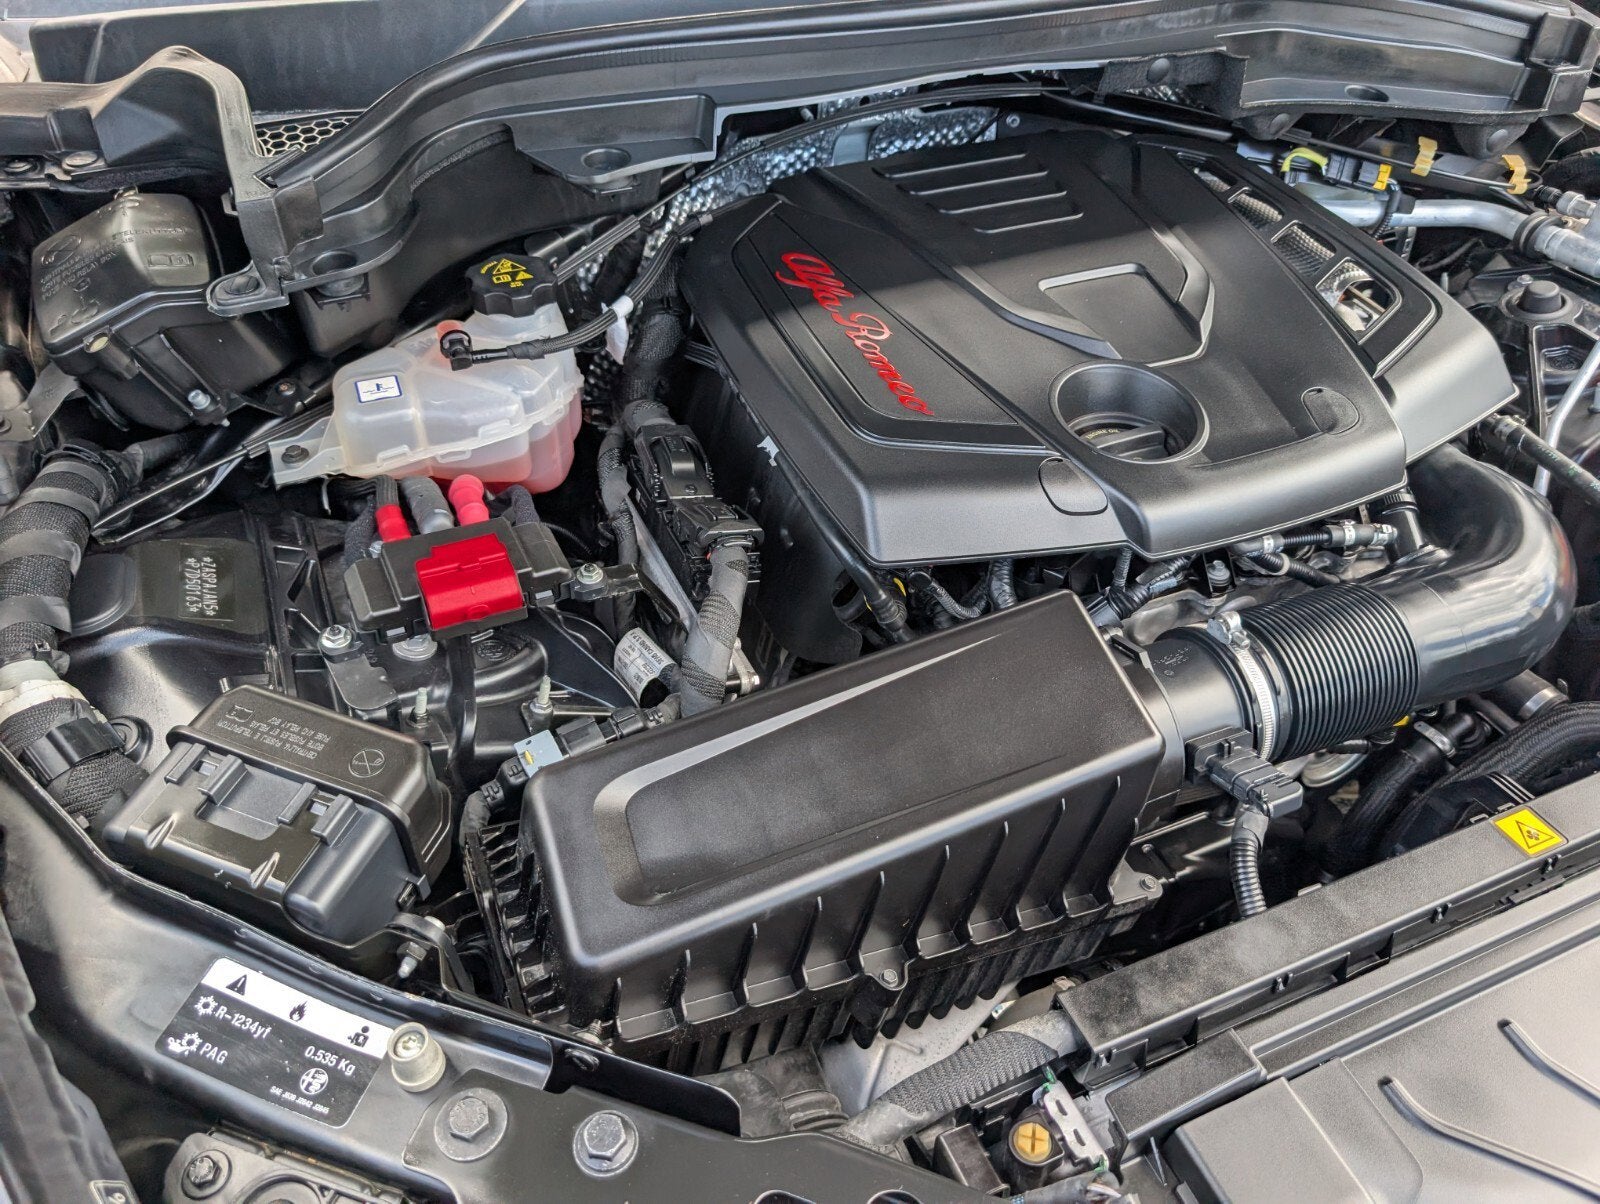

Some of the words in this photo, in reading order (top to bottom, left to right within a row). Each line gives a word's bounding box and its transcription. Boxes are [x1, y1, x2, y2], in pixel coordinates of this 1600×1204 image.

[775, 252, 854, 313] Alfa
[832, 312, 934, 415] Romeo
[214, 1005, 272, 1039] R-1234yf
[199, 1042, 228, 1064] PAG
[304, 1045, 338, 1067] 0.535
[337, 1058, 356, 1076] Kg
[269, 1085, 283, 1096] SAE
